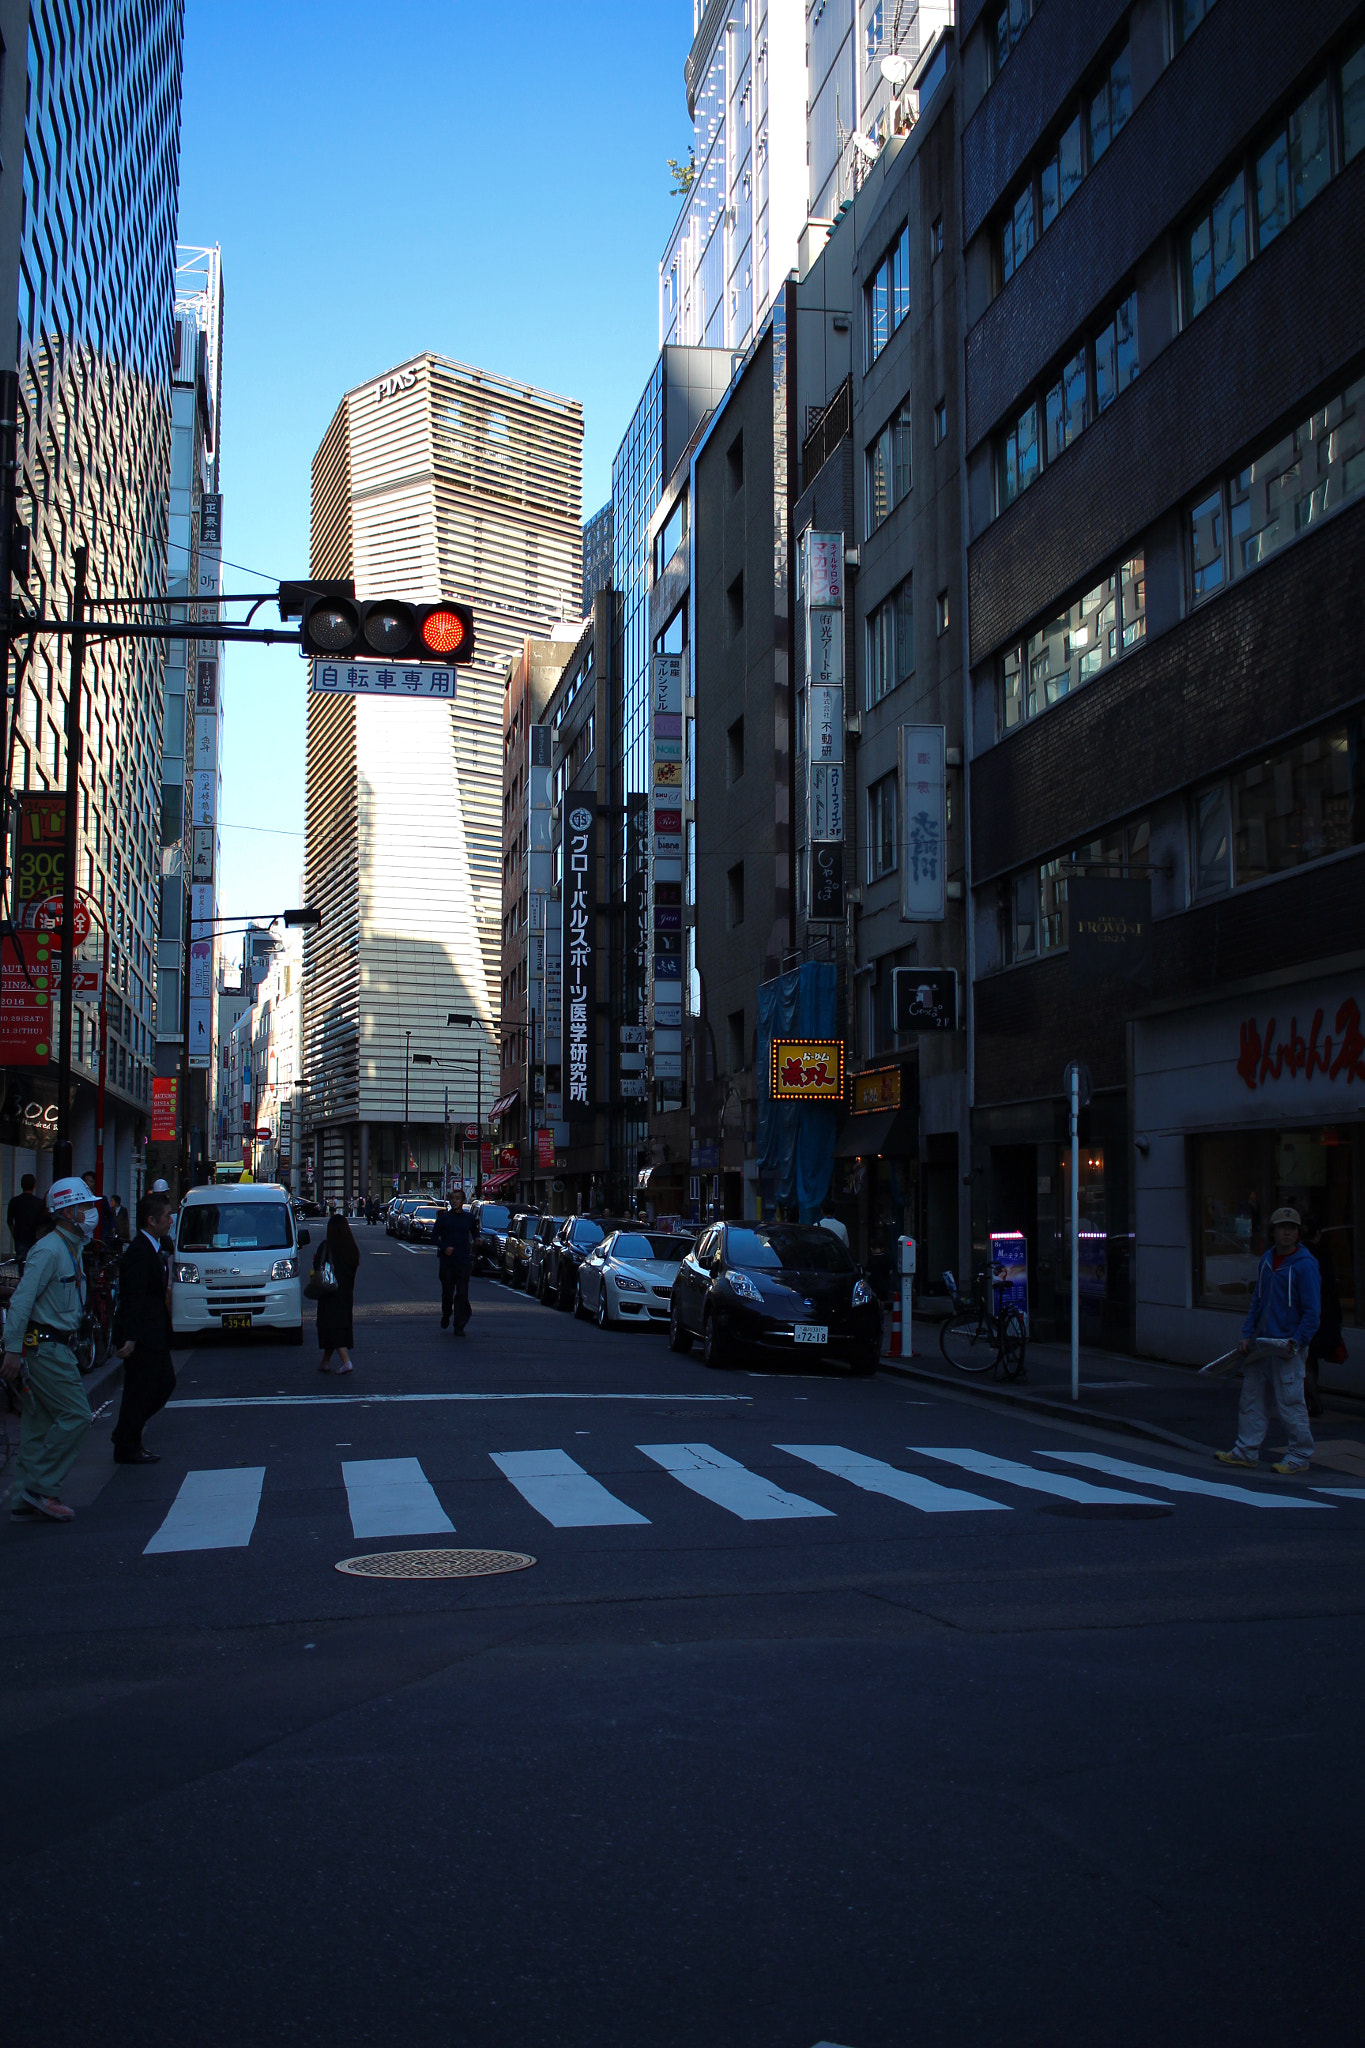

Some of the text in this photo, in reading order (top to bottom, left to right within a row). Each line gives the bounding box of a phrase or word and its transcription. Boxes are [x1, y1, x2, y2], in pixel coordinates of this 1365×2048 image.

[813, 542, 828, 594] マカロン
[830, 543, 838, 584] ネイルサロン
[322, 665, 450, 693] 自転車専用
[669, 660, 680, 677] 銀座
[820, 672, 832, 680] 5F
[658, 659, 668, 710] マルシマビル
[821, 721, 832, 757] 不動研
[831, 768, 841, 827] スリーファイブ
[829, 828, 842, 836] 3F
[803, 1052, 830, 1061] らーめん
[780, 1057, 836, 1088] 無双
[802, 1331, 826, 1342] 72-18
